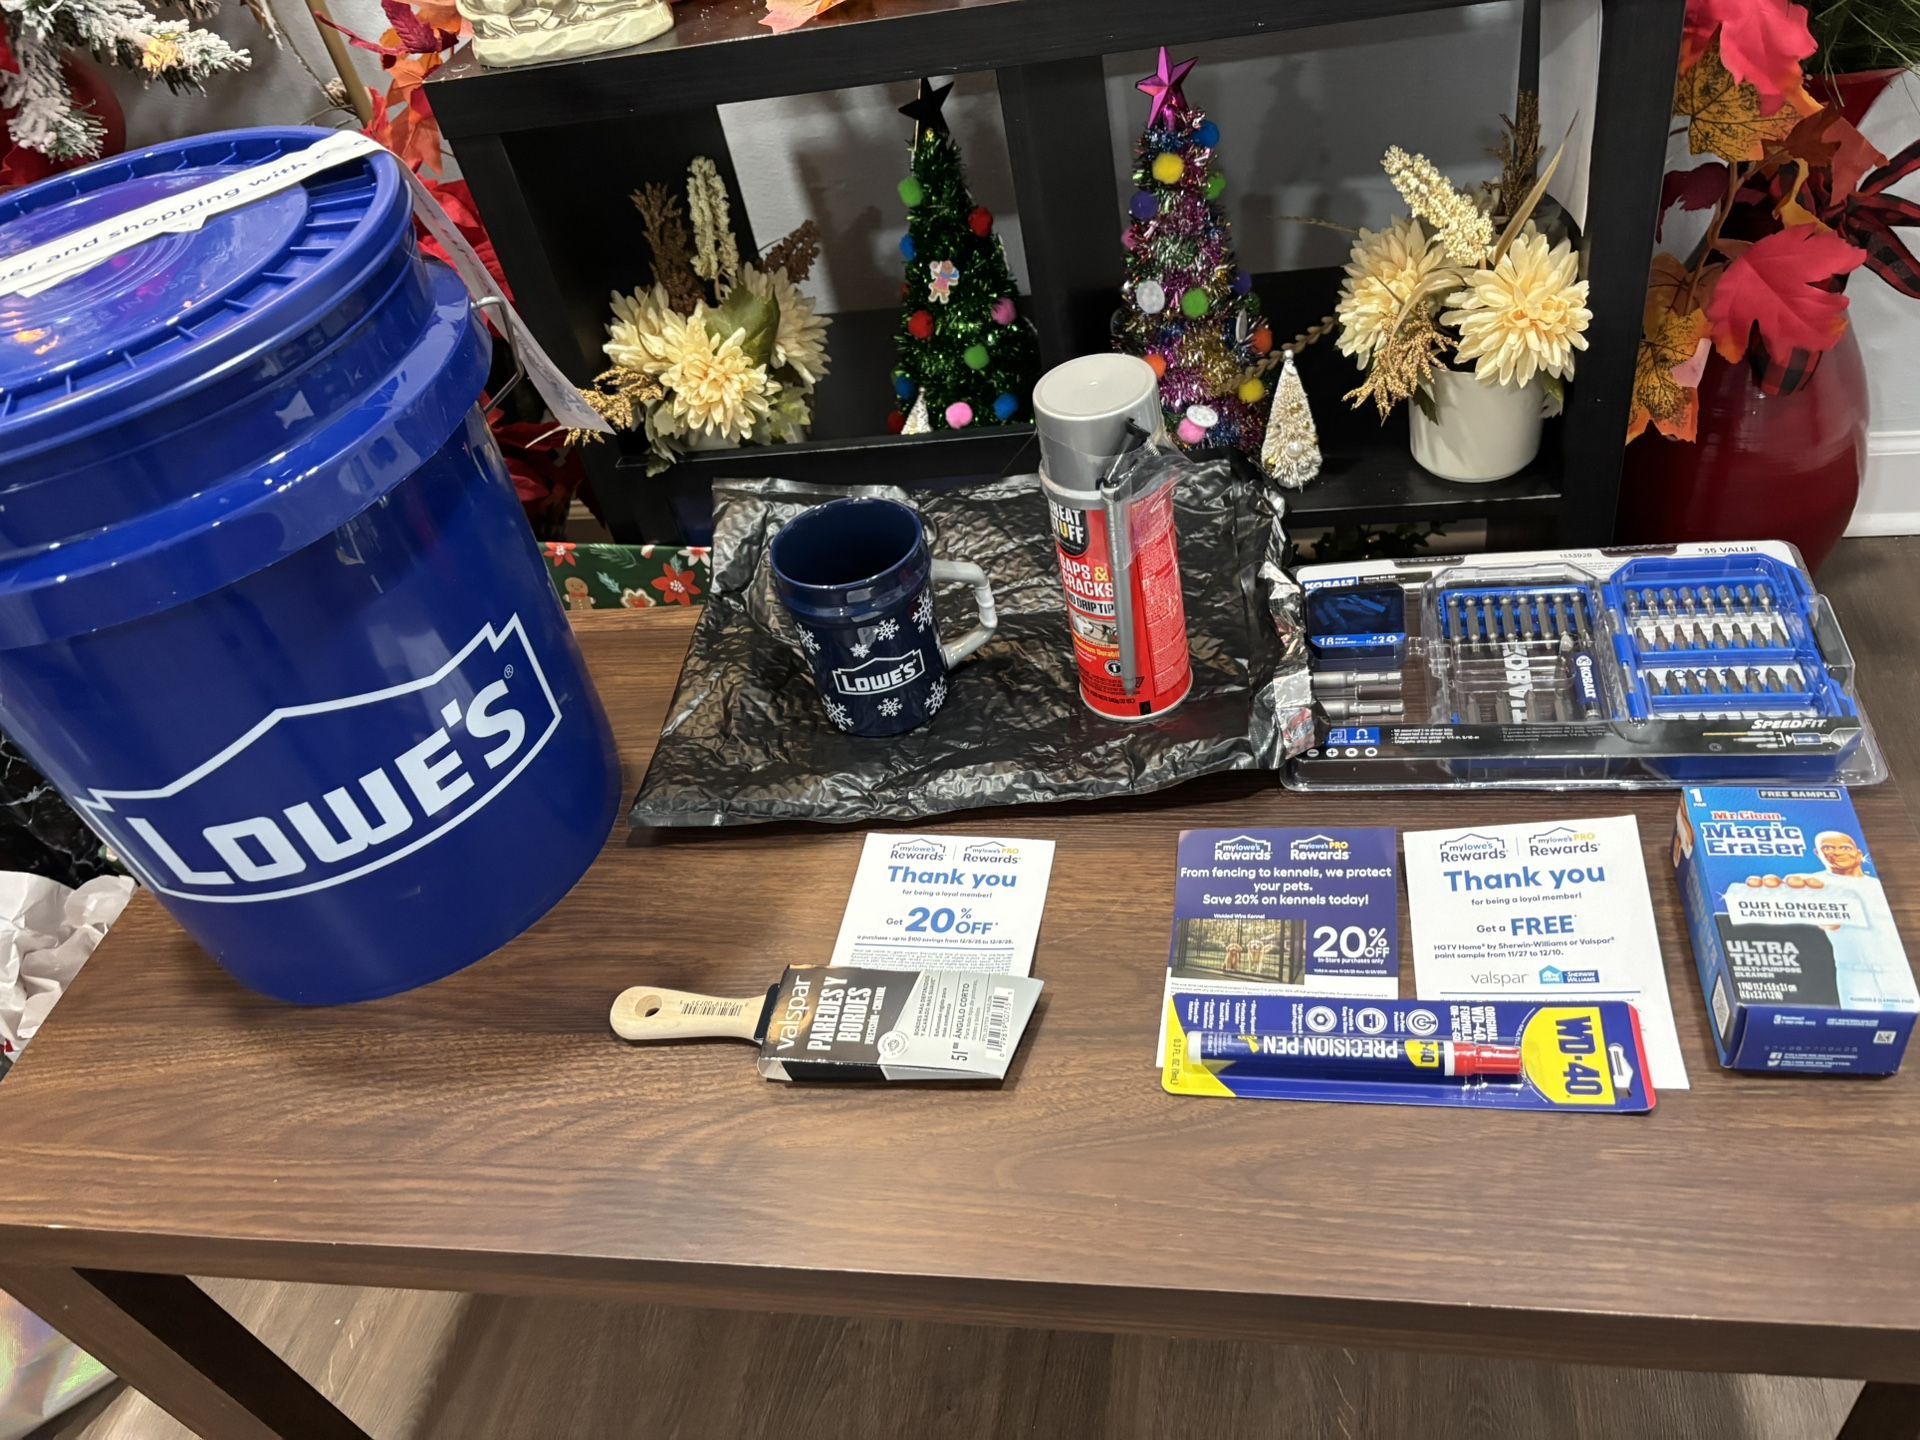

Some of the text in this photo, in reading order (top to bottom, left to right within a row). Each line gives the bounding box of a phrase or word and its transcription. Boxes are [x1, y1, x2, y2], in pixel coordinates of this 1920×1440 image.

[46, 236, 99, 263] and
[108, 184, 242, 240] shopping
[248, 164, 308, 187] with
[1093, 565, 1110, 583] &
[1304, 578, 1355, 591] KOBALT
[1076, 597, 1097, 613] DRIP
[1098, 602, 1115, 615] TIP
[1320, 637, 1335, 646] 18
[841, 662, 915, 692] LOWE'S
[1579, 666, 1597, 698] KOBALT
[1751, 718, 1826, 730] SPEEDFIT
[126, 679, 527, 885] LOWE'S
[1690, 788, 1838, 802] 1 FREE SAMPLE
[1739, 811, 1781, 821] Clean
[1702, 823, 1801, 842] Magic
[900, 845, 935, 853] mylowe's
[1002, 847, 1019, 855] PRO
[1223, 841, 1348, 852] mylowe's mylowe's PRO
[1449, 832, 1596, 852] mylowe's mylowe's PRO
[1708, 840, 1805, 855] Eraser
[890, 850, 1018, 864] Rewards Rewards
[1214, 849, 1350, 861] Rewards Rewards
[1440, 842, 1598, 863] Rewards Rewards
[887, 865, 1017, 889] Thank you
[1180, 866, 1392, 880] From fencing to kennels, we protect
[1443, 866, 1606, 892] Thank you
[914, 889, 934, 898] being
[942, 890, 959, 898] loyal
[960, 891, 993, 899] member!
[1254, 881, 1313, 893] your pets.
[1203, 893, 1369, 907] Save 20% on kennels today!
[1471, 898, 1484, 906] for
[1485, 897, 1510, 906] being
[1519, 894, 1541, 903] loyal
[1542, 892, 1582, 901] member!
[1738, 901, 1848, 912] OUR LONGEST
[886, 917, 903, 926] Get
[905, 906, 955, 934] 20
[1741, 910, 1851, 920] LASTING ERASER
[1476, 924, 1497, 934] Get
[1510, 915, 1575, 936] FREE
[1313, 926, 1367, 958] 20
[1364, 947, 1390, 958] OFF
[1434, 943, 1457, 951] HGTV
[1487, 942, 1497, 951] by
[1498, 939, 1568, 950] Sherwin-Williams
[1726, 940, 1800, 955] ULTRA
[1341, 957, 1371, 965] purchases
[1371, 957, 1385, 965] only
[1434, 951, 1455, 960] paint
[1457, 951, 1485, 960] sample
[1487, 951, 1506, 959] from
[1507, 950, 1528, 958] 11/27
[1729, 953, 1800, 967] THICK
[1470, 969, 1528, 987] valspar
[1733, 966, 1802, 974] MULTI-PURPOSE
[777, 975, 812, 1051] valspar
[807, 976, 848, 1051] PAREDES Y
[836, 987, 872, 1042] BORDES
[953, 983, 970, 1039] ÁNGULO CORTO
[1450, 1005, 1461, 1041] ON-THE-GO
[1459, 1006, 1472, 1041] FORMULA
[1471, 1006, 1487, 1041] WD-40
[1484, 1006, 1498, 1042] ORIGINAL
[950, 1050, 968, 1061] 51
[1263, 1036, 1399, 1058] PRECISION PEN
[1556, 1016, 1603, 1096] WD-40
